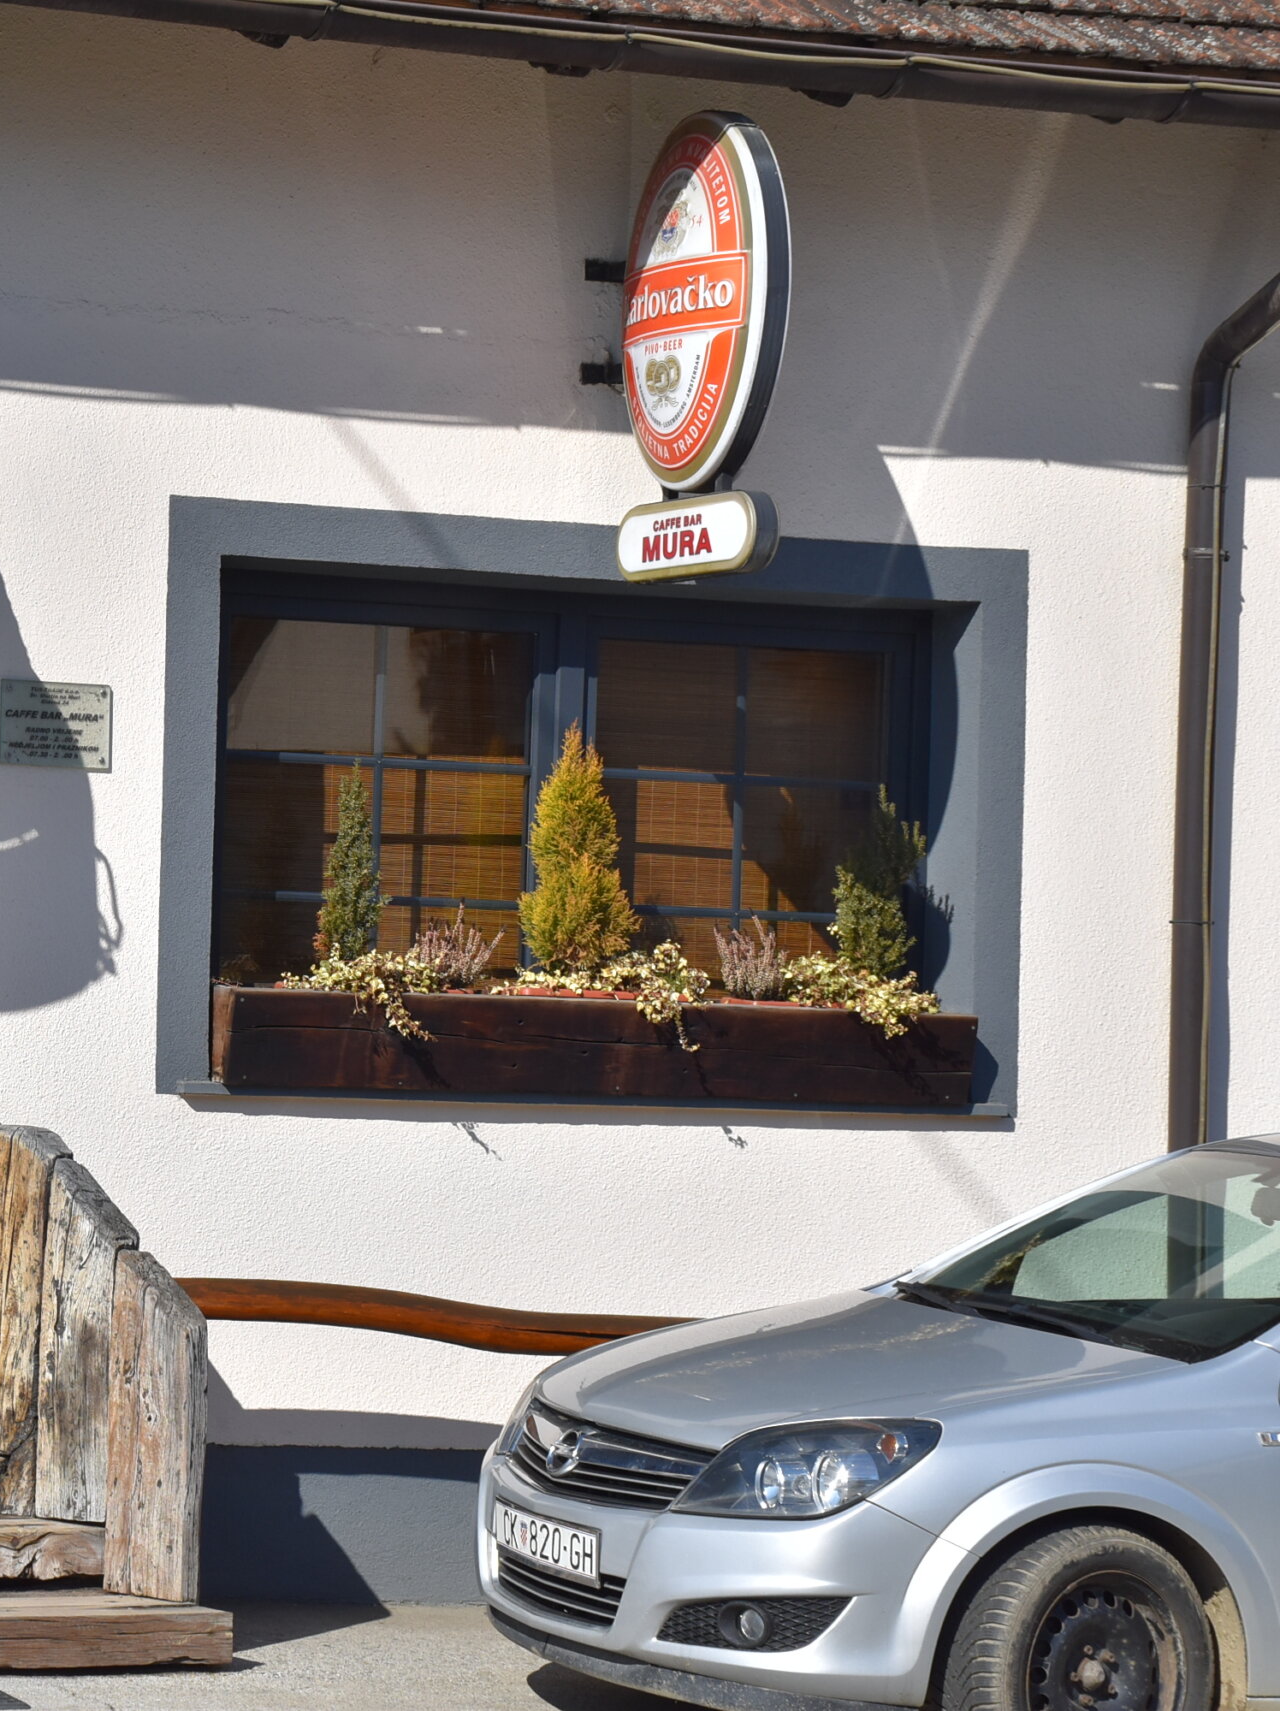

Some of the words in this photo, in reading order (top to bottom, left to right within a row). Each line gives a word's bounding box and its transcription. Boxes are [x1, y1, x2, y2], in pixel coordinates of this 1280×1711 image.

[686, 354, 701, 398] AMSTERDAM
[672, 383, 719, 457] TRADICIJA
[652, 516, 681, 532] CAFFE
[683, 513, 702, 527] BAR
[641, 527, 713, 563] MURA
[5, 709, 38, 719] CAFFE
[39, 711, 62, 720] BAR
